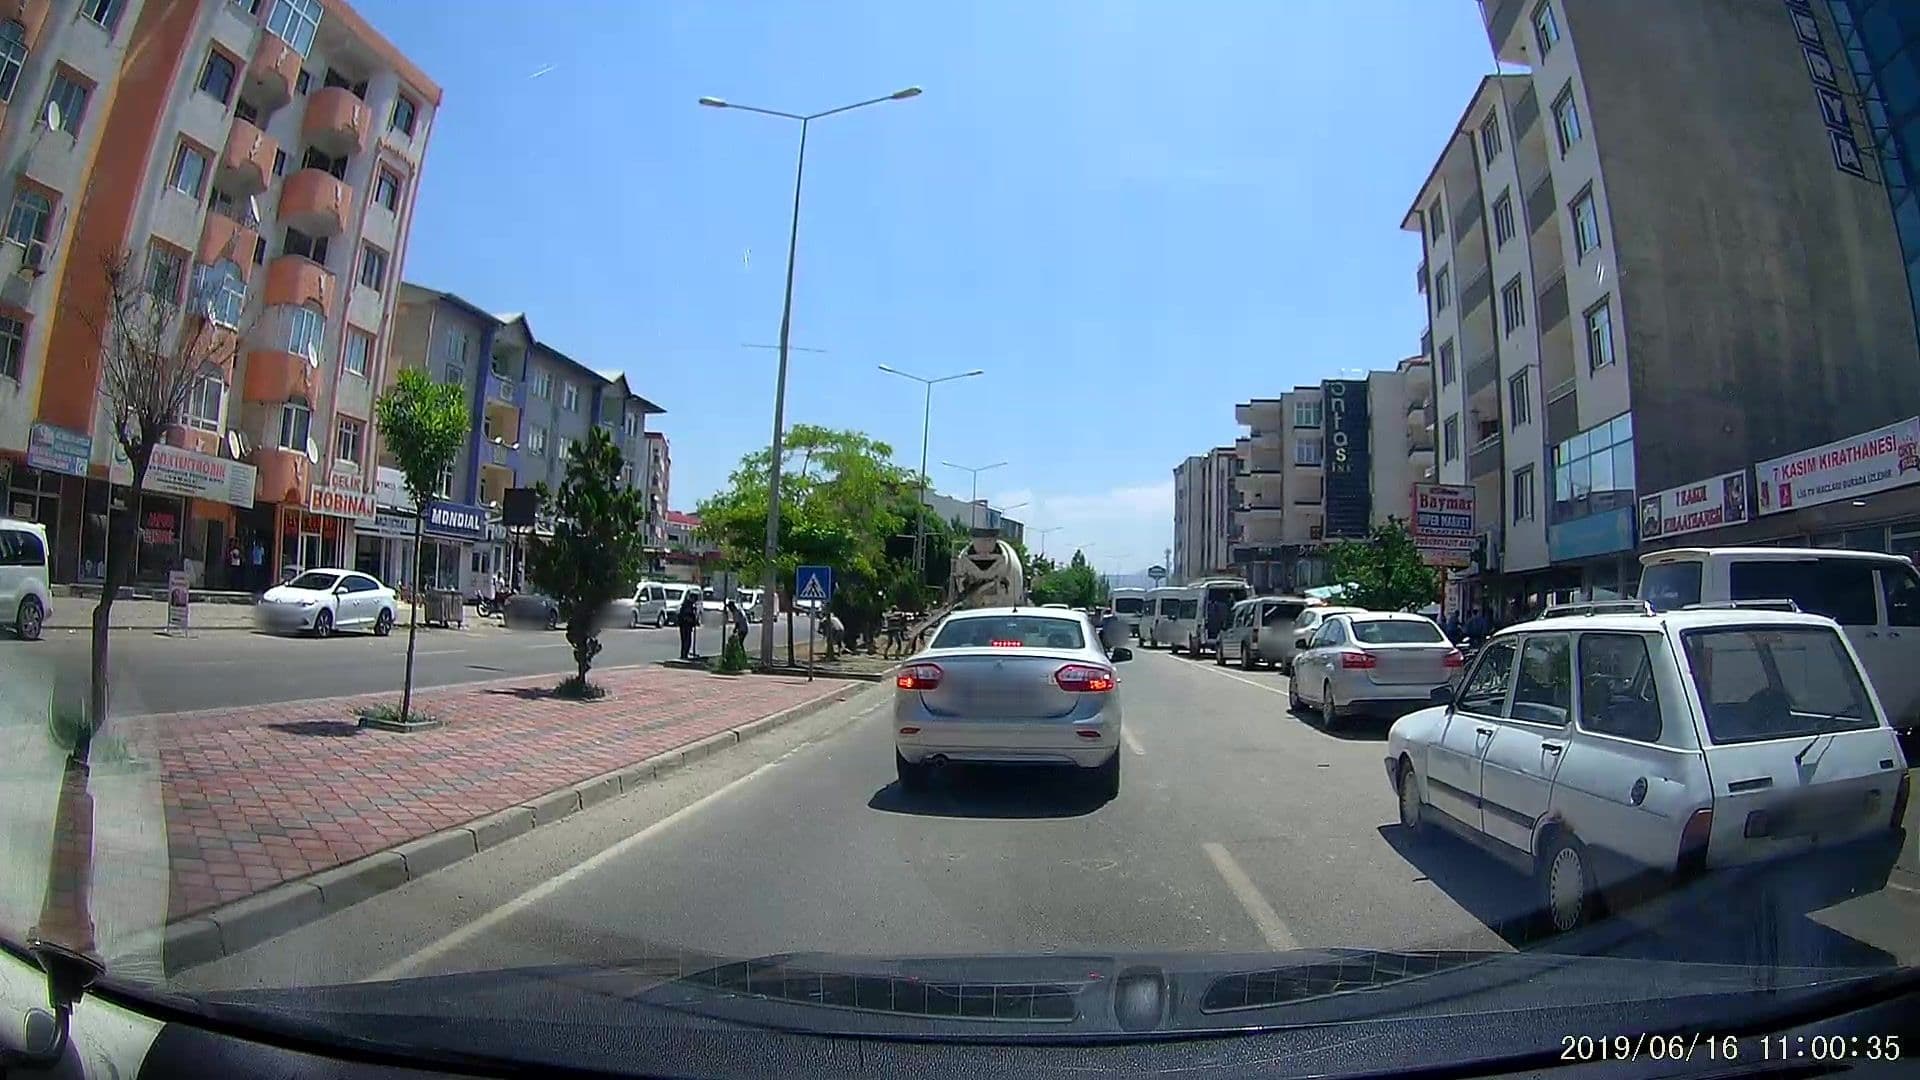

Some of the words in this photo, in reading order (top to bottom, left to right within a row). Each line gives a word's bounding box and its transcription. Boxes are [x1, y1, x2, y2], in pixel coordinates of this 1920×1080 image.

[1782, 456, 1816, 481] KASIM
[1420, 495, 1472, 511] Baymar
[431, 508, 480, 530] MONDIAL
